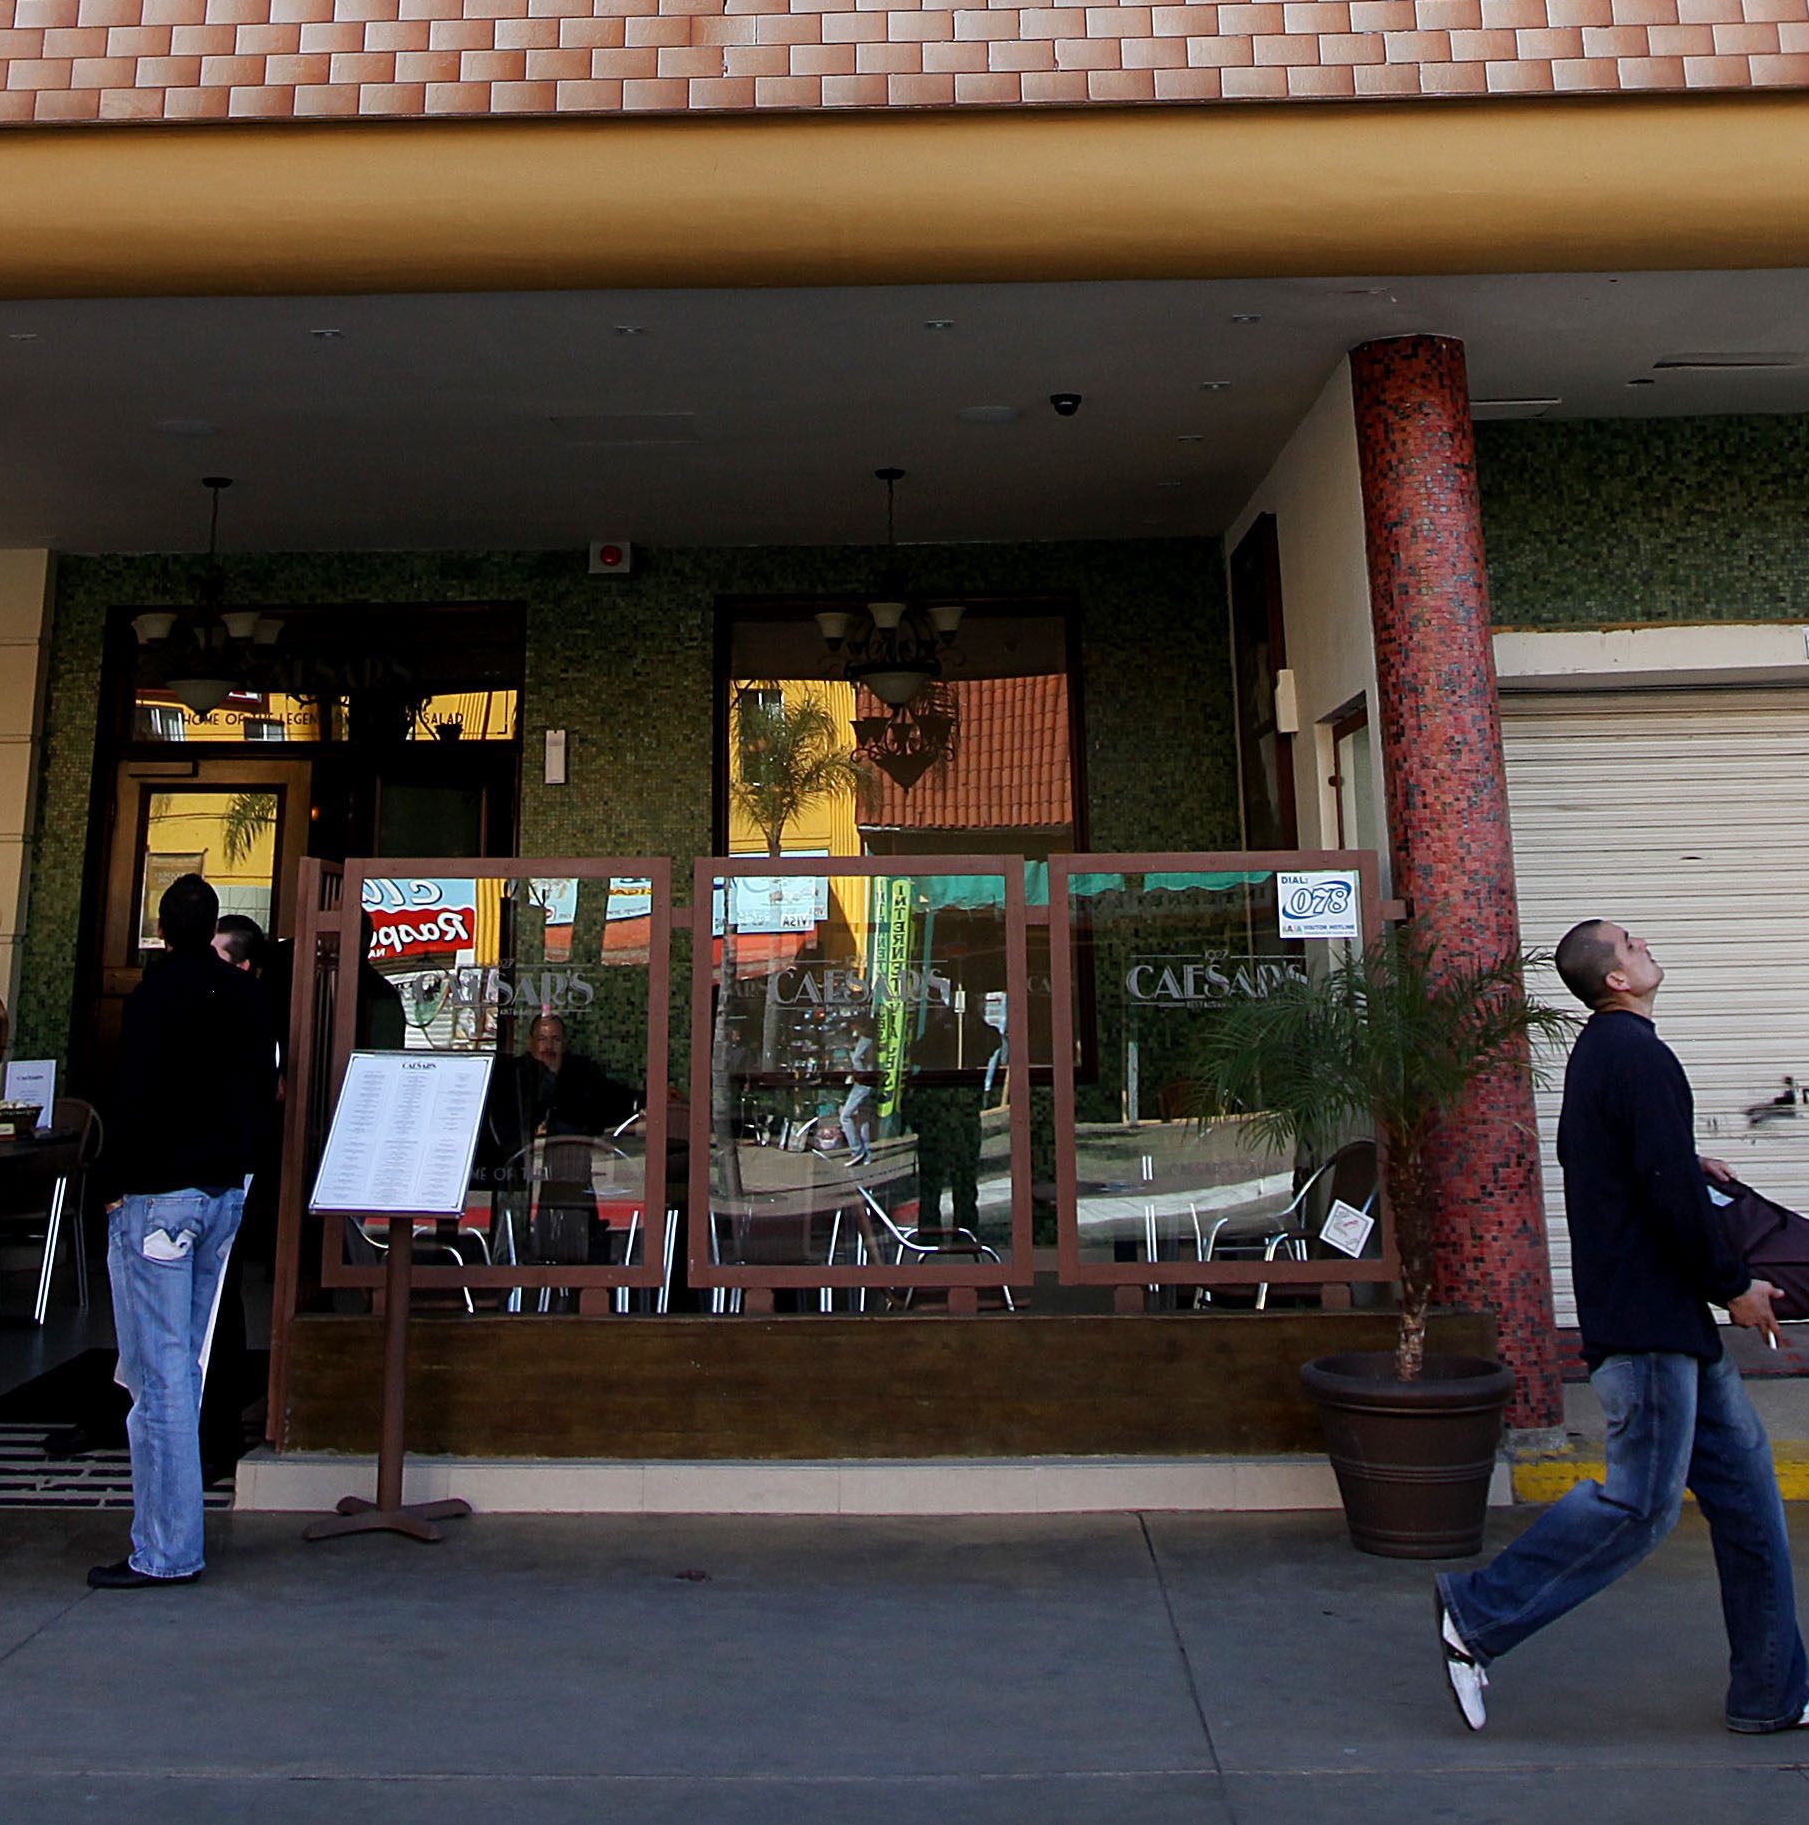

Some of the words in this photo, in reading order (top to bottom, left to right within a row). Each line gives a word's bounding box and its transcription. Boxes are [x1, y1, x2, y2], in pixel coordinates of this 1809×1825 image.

[225, 712, 243, 727] OF
[422, 712, 465, 727] SALAD
[1280, 876, 1308, 885] DIAL:
[1290, 886, 1349, 915] 078
